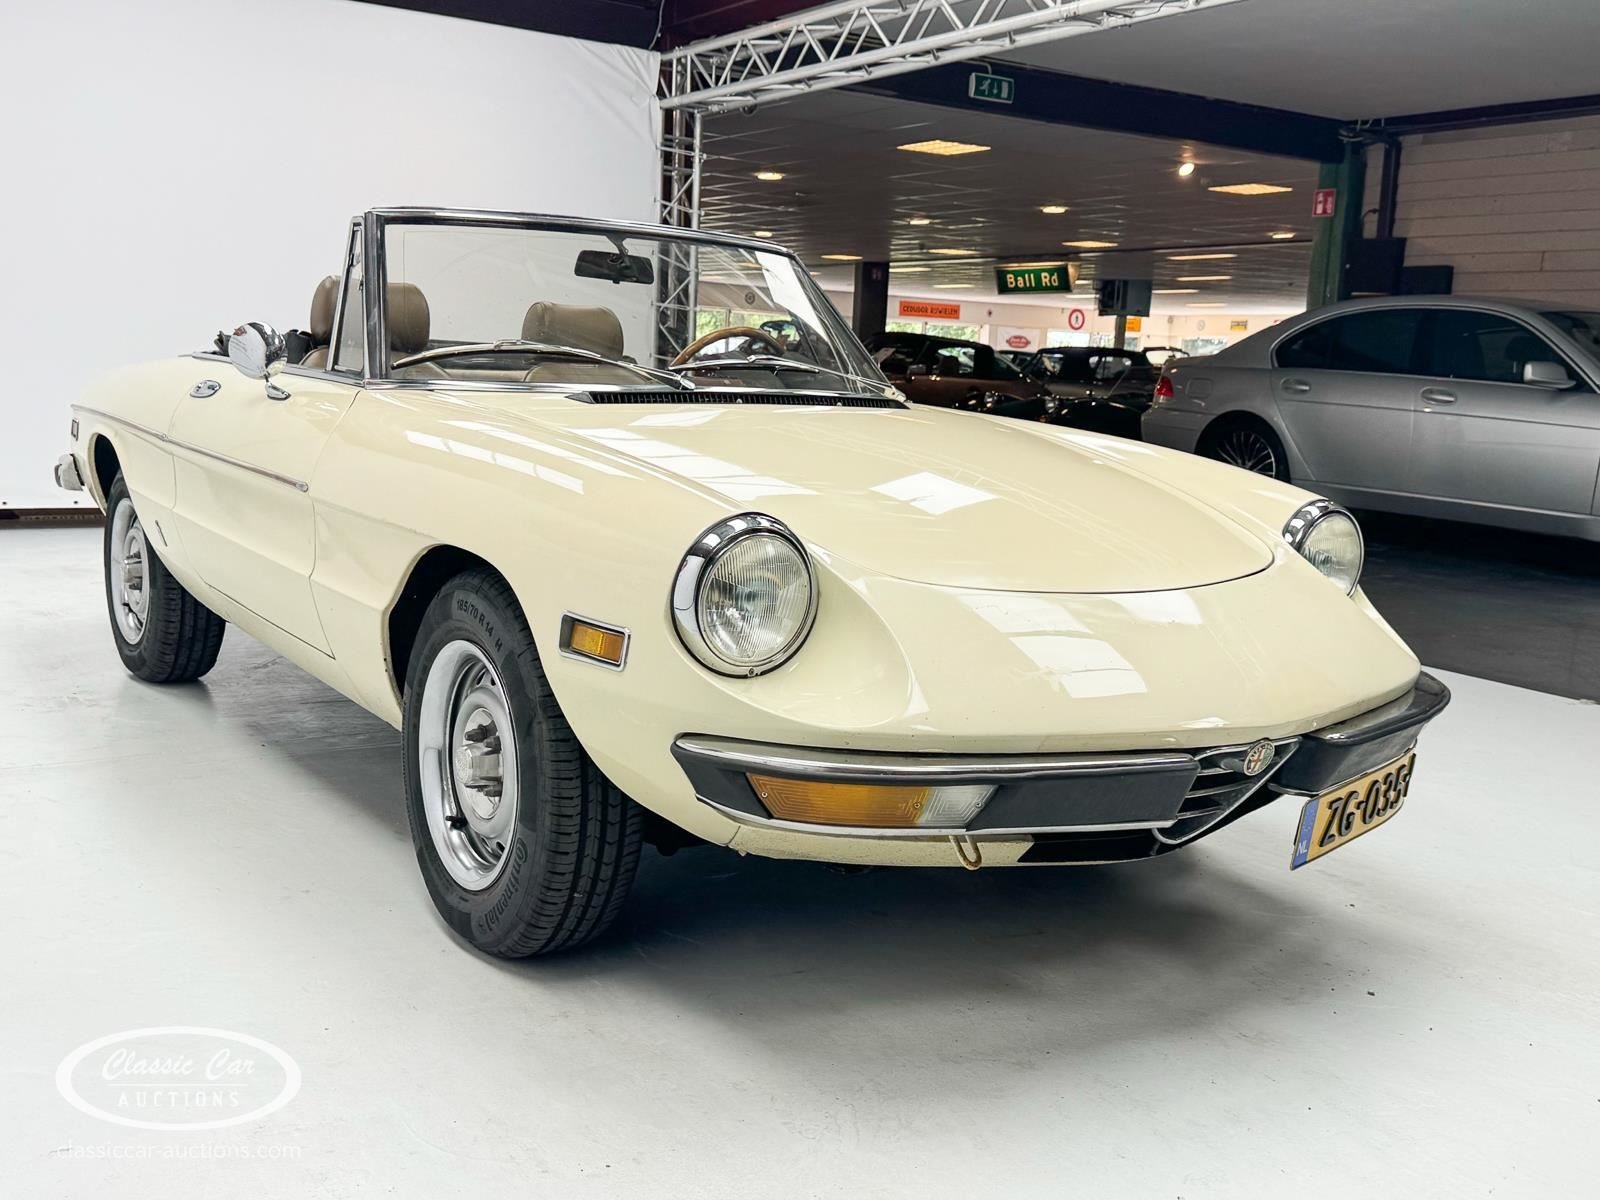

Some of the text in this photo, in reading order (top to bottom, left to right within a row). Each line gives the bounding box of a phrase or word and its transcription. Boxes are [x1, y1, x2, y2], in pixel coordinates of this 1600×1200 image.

[1006, 272, 1059, 288] Ball Rd
[457, 600, 479, 620] 185/70
[479, 613, 486, 627] R
[485, 622, 495, 638] 14
[483, 837, 528, 932] Continental
